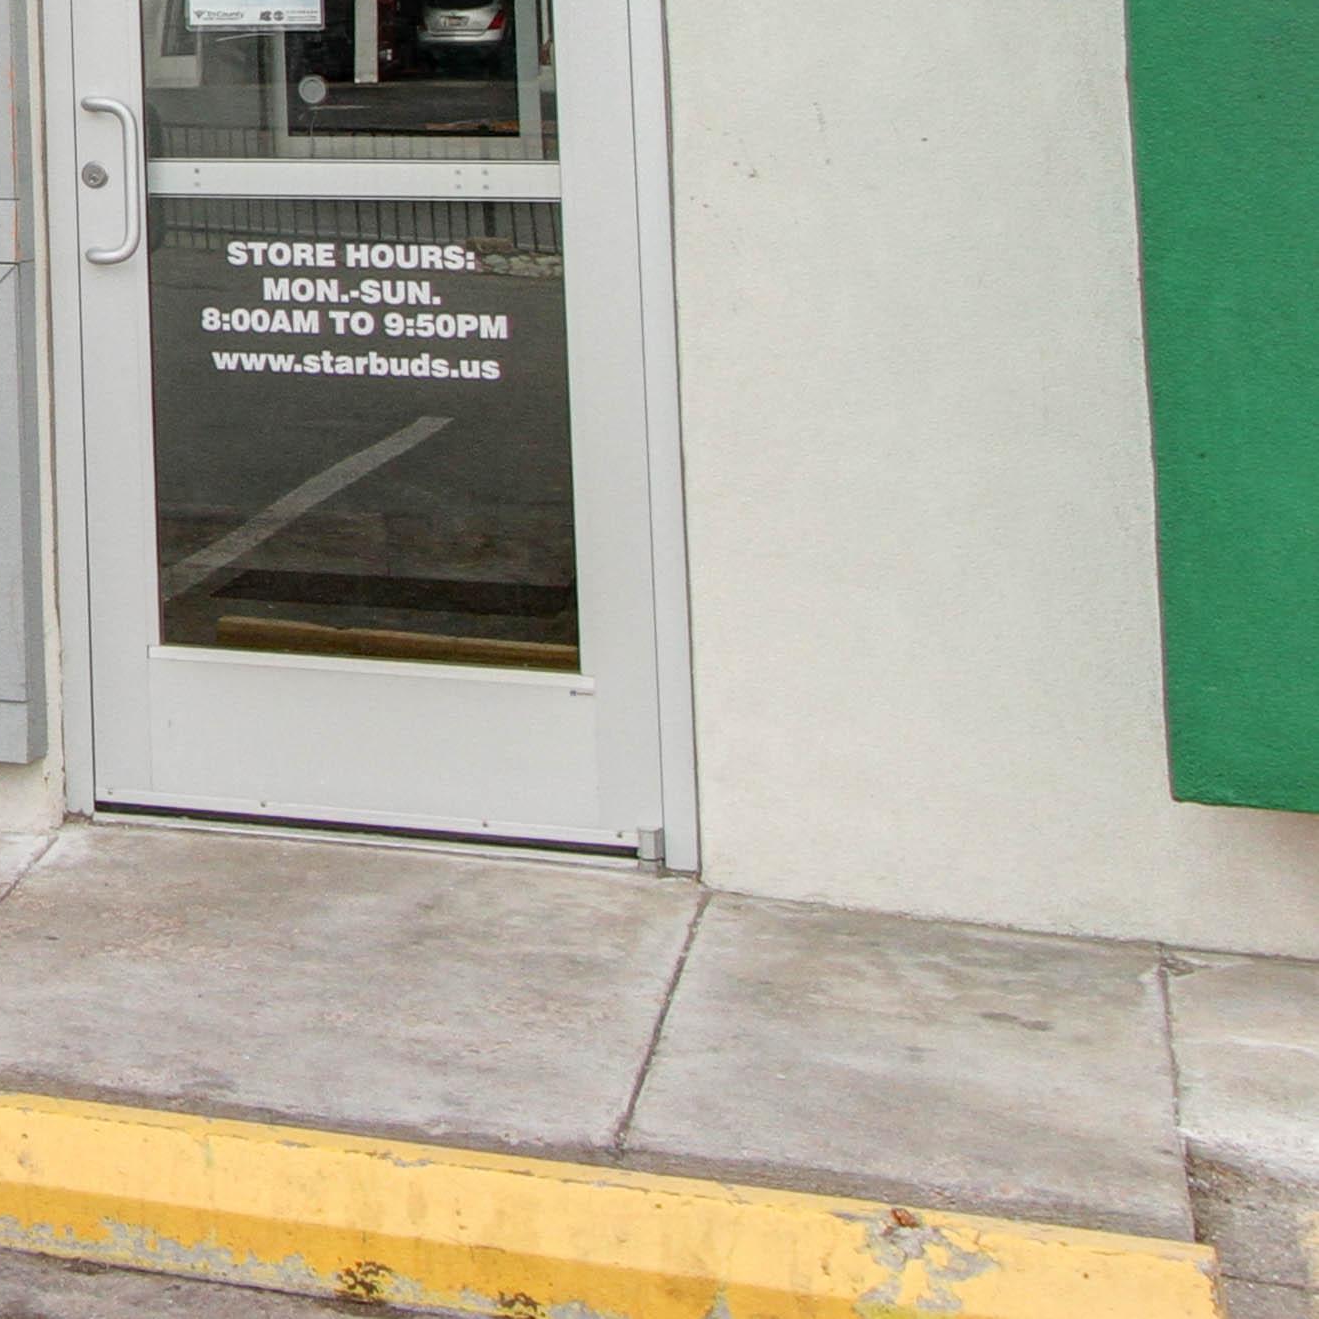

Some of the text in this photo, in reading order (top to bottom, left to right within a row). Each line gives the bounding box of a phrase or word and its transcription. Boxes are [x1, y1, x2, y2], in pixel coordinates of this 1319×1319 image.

[226, 240, 476, 271] STORE HOURS:
[262, 276, 442, 306] MON.-SUN.
[201, 307, 509, 340] 8:00AM TO 9:50PM
[211, 349, 501, 381] www.starbuds.us
